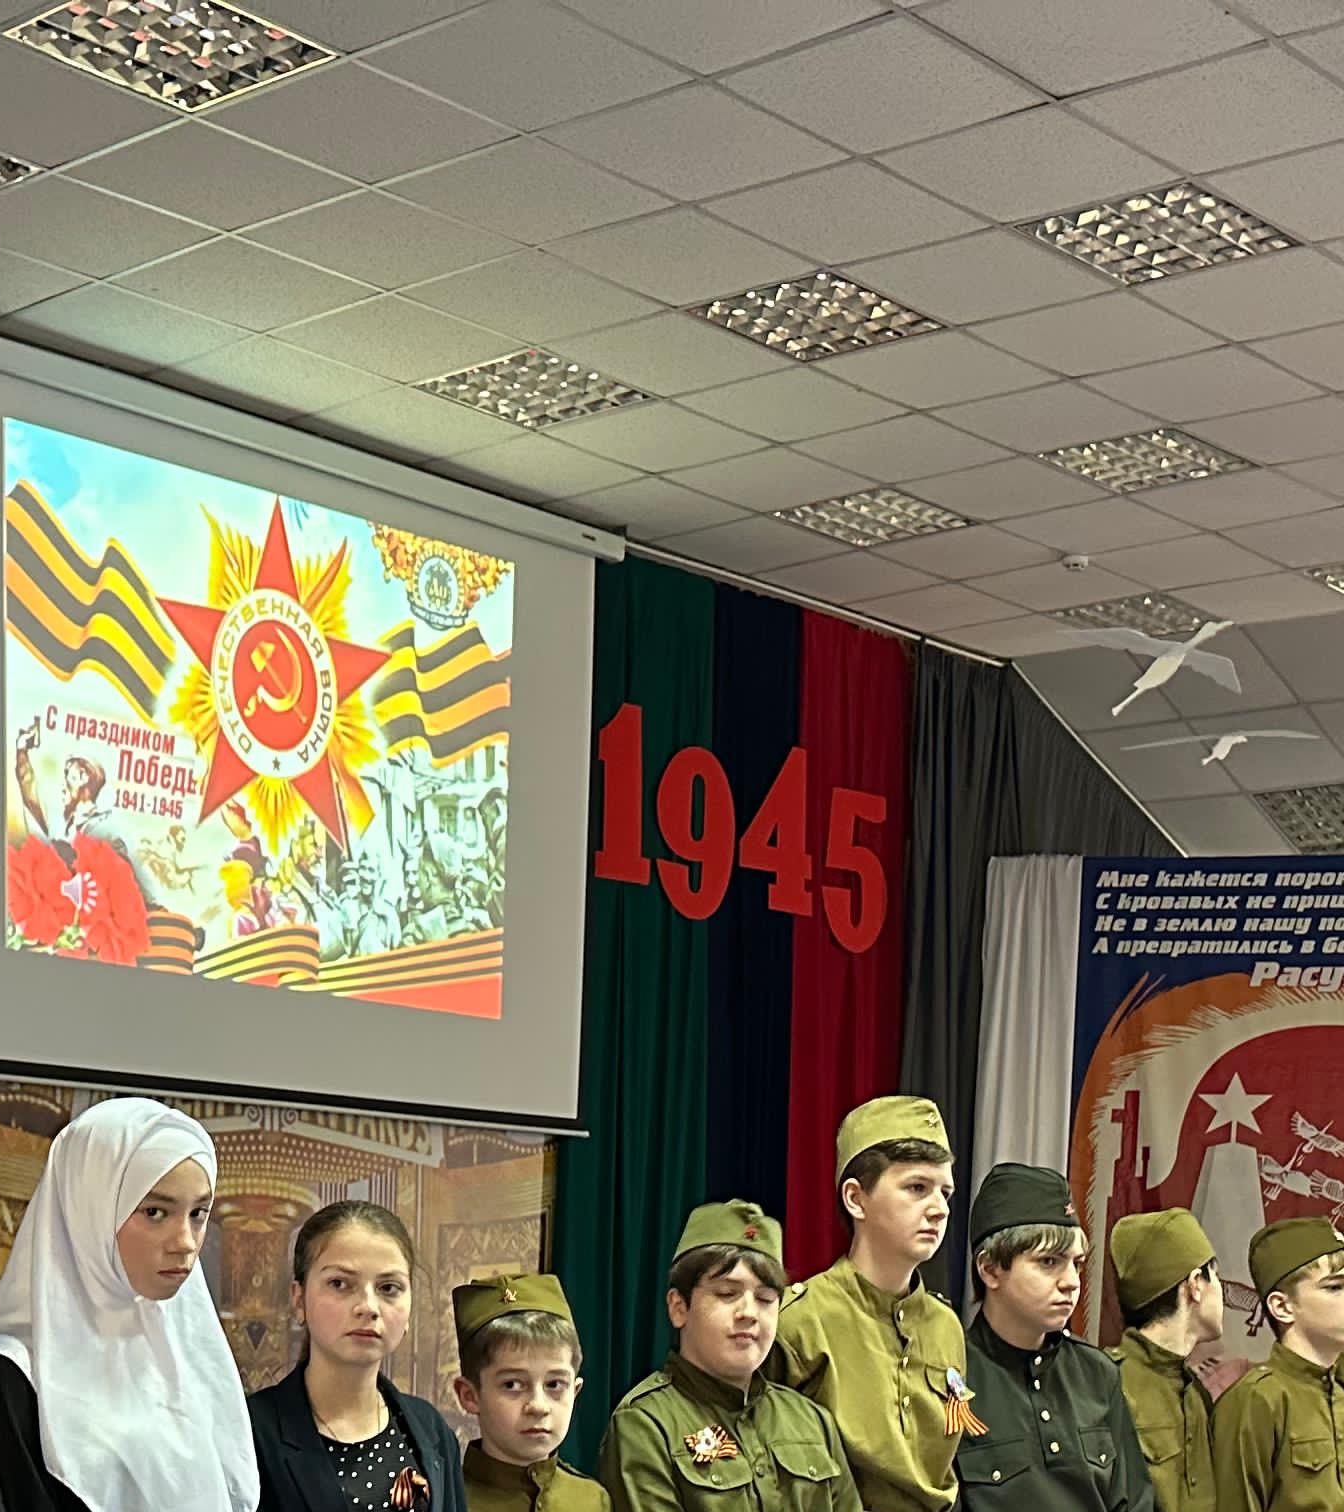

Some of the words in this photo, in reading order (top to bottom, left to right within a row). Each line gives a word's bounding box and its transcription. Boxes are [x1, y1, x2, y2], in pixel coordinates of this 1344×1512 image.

[218, 597, 324, 754] ОТЕЧЕСТВЕННАЯ
[46, 705, 58, 730] С
[65, 713, 175, 756] праздником
[113, 788, 183, 819] 1941-1945
[595, 702, 887, 953] 1945
[1096, 871, 1149, 888] Мне
[1155, 870, 1268, 888] кажется
[1096, 893, 1111, 910] С
[1116, 893, 1239, 912] кровавых
[1246, 895, 1276, 910] не
[1094, 915, 1127, 932] Не
[1132, 917, 1147, 932] в
[1153, 916, 1238, 933] землю
[1243, 916, 1312, 934] нашу
[1092, 937, 1109, 954] А
[1116, 938, 1293, 957] превратились
[1300, 939, 1316, 954] в
